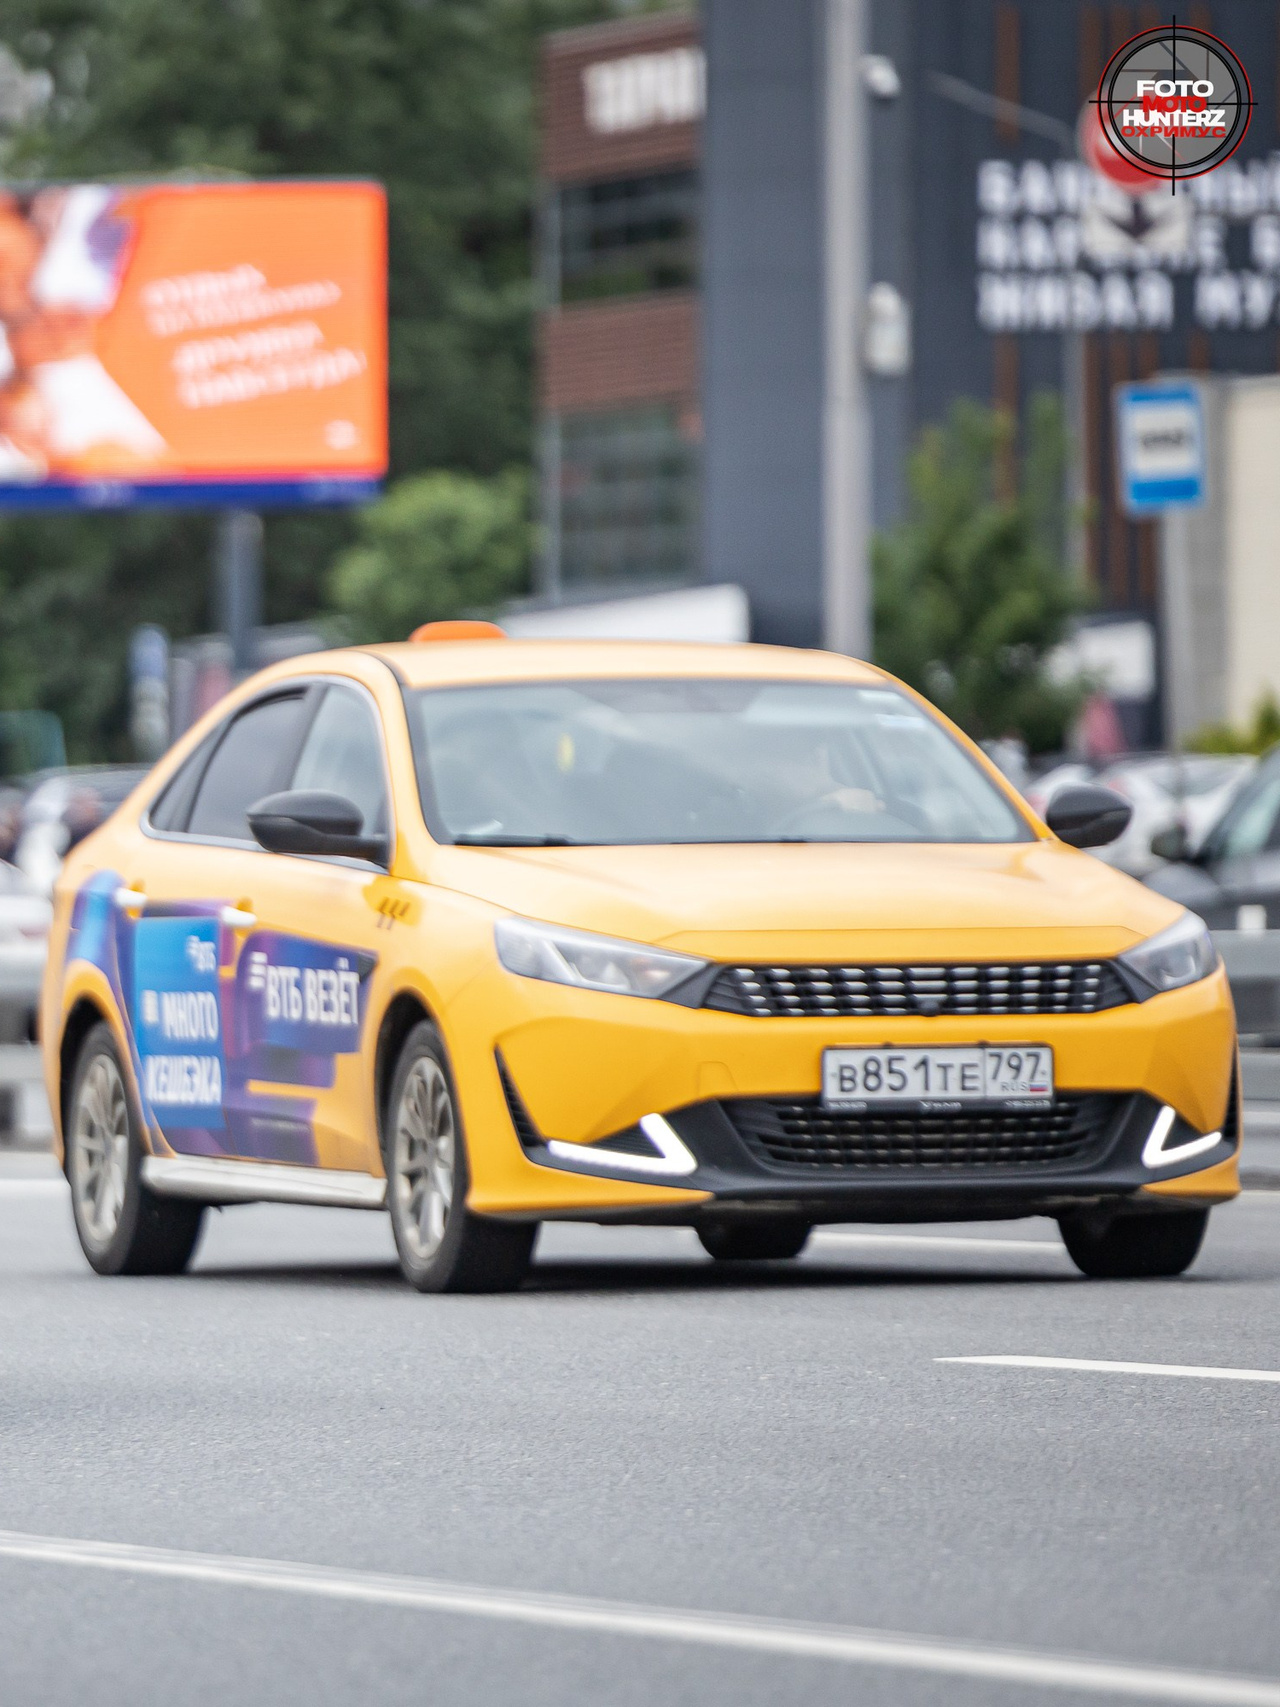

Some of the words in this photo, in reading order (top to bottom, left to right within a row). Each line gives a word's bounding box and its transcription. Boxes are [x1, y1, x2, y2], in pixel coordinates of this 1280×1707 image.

[266, 965, 303, 1020] ВТБ
[303, 957, 360, 1025] ВЕЗЁТ
[161, 990, 219, 1041] МНОГО
[838, 1054, 980, 1093] В851ТЕ
[988, 1051, 1042, 1081] 797
[1001, 1081, 1028, 1092] RUS
